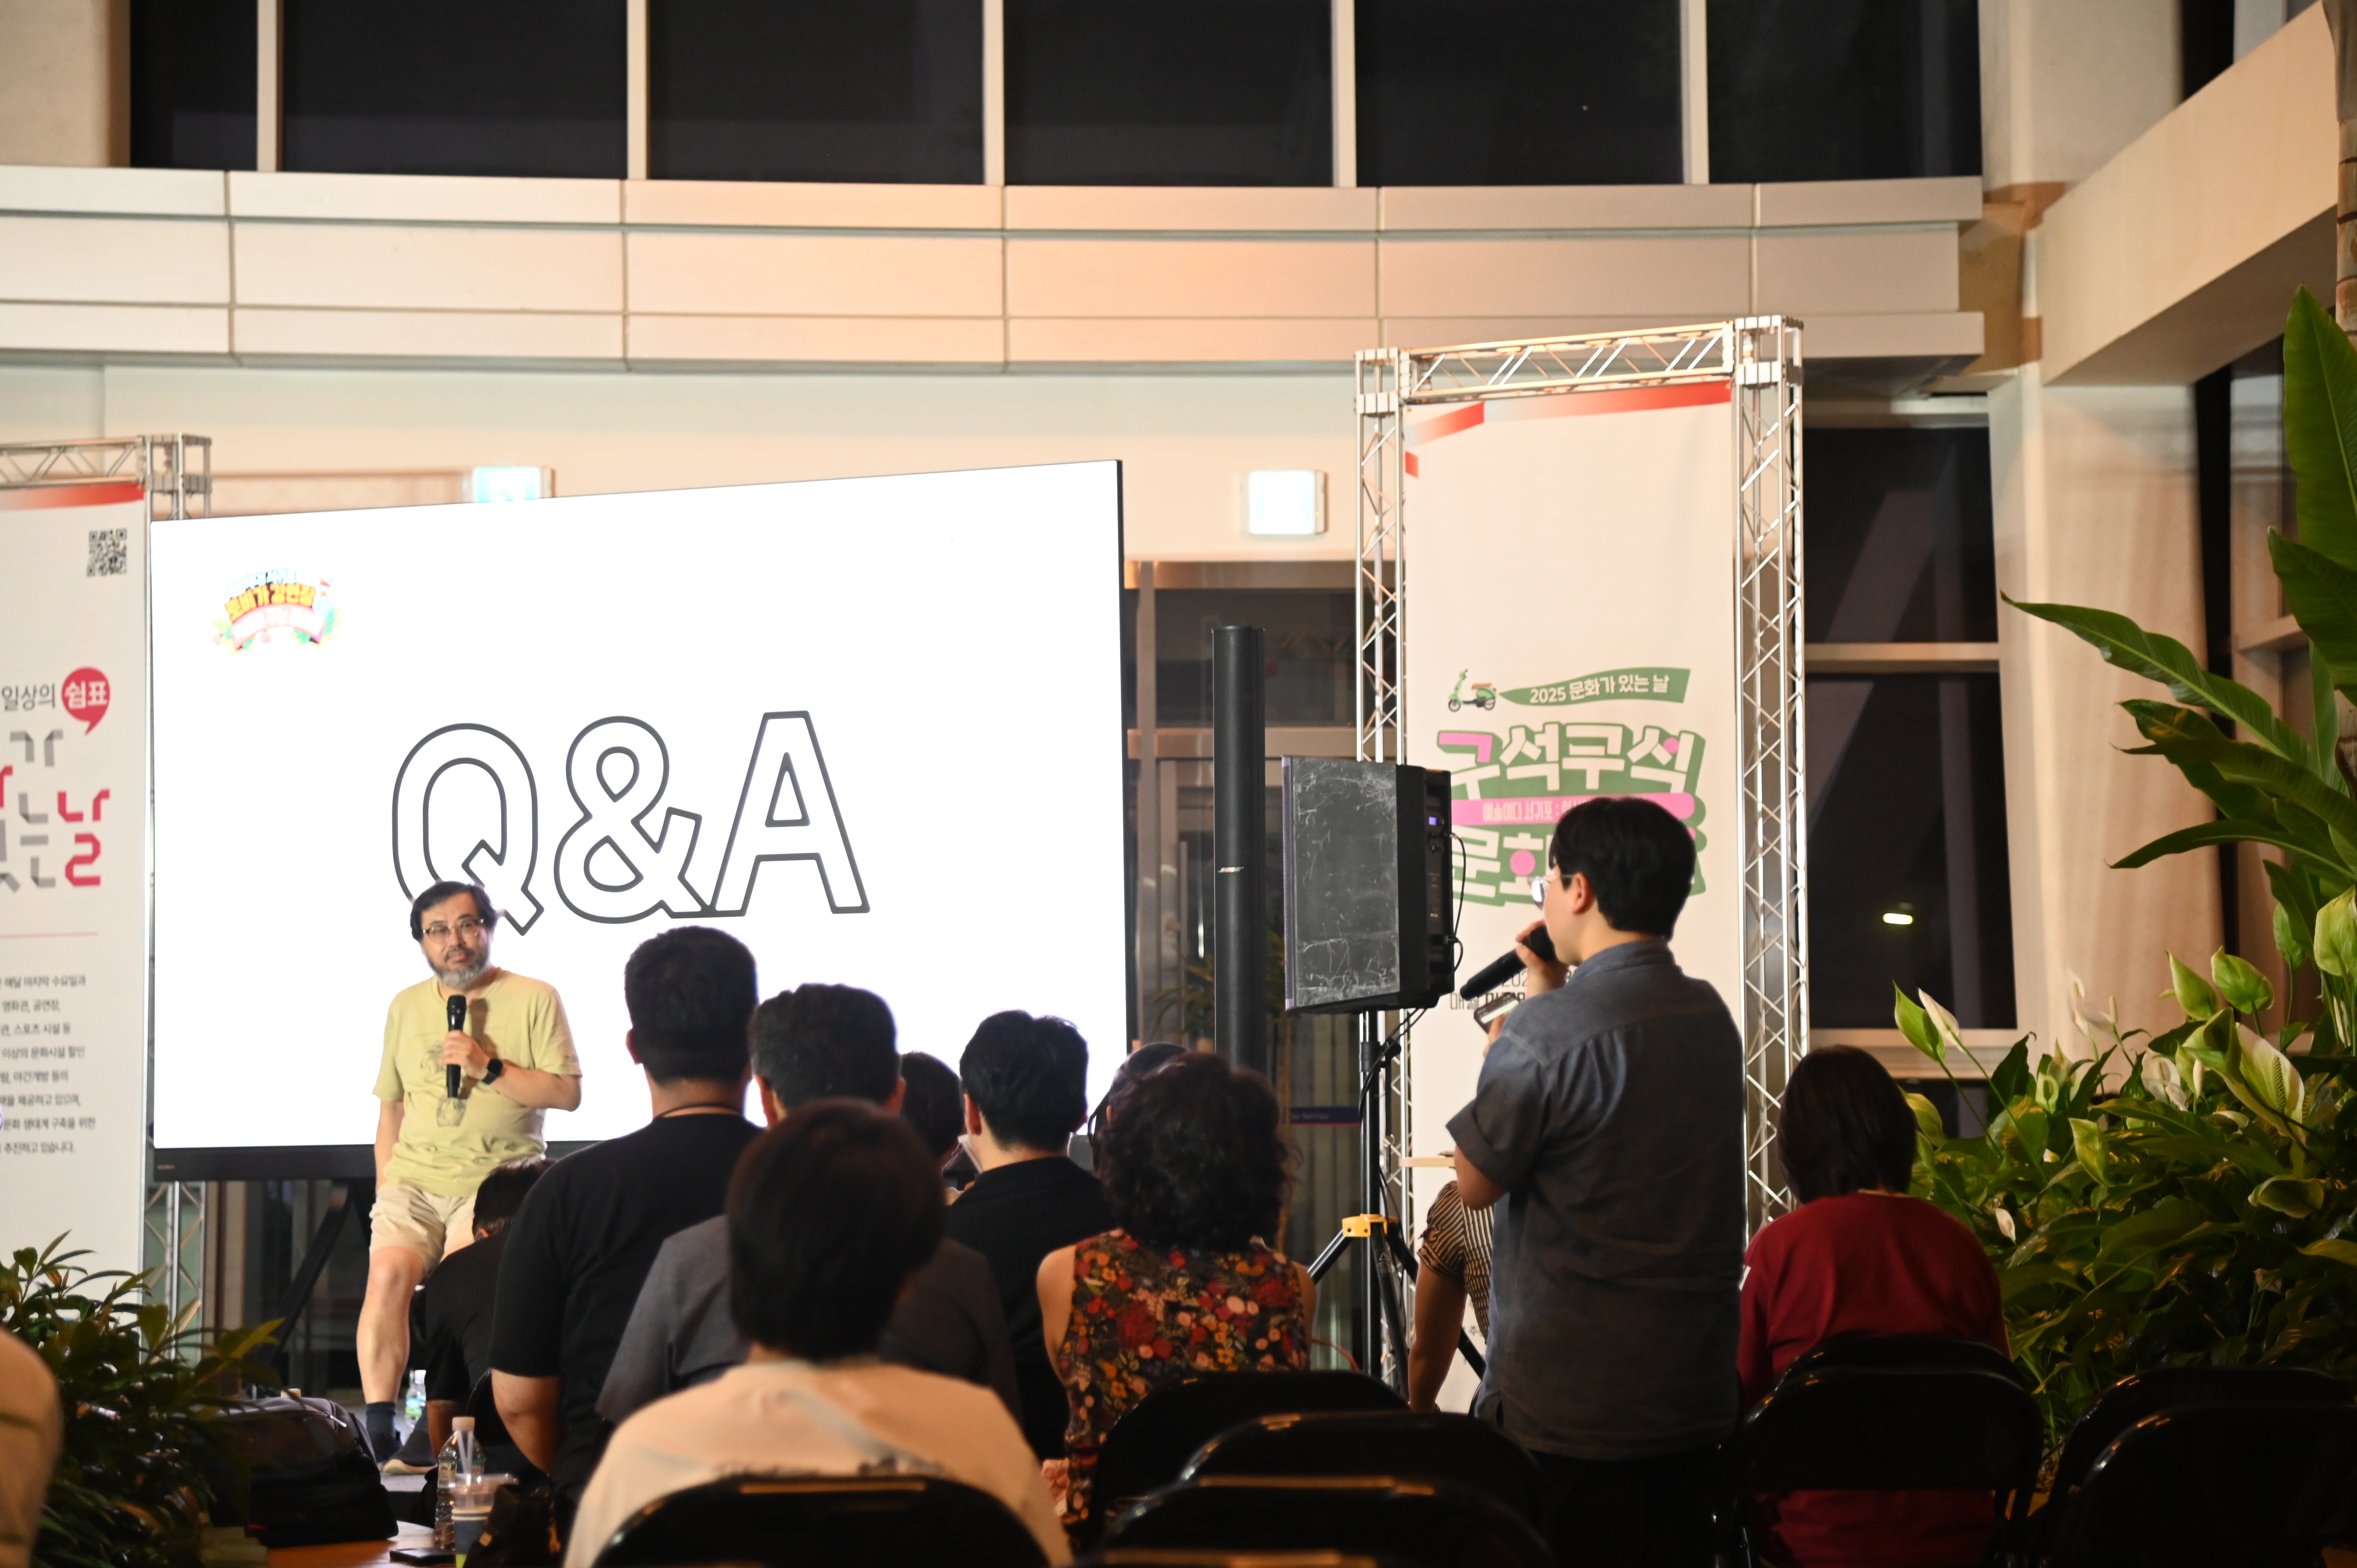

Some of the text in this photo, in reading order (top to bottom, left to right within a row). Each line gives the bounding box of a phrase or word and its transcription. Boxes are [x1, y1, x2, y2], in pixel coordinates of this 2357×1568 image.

[2, 680, 109, 711] 일상의 쉼표
[1530, 675, 1670, 703] 2025 문화가 있는 날
[1437, 723, 1695, 800] 구석구석
[392, 710, 871, 936] Q&A
